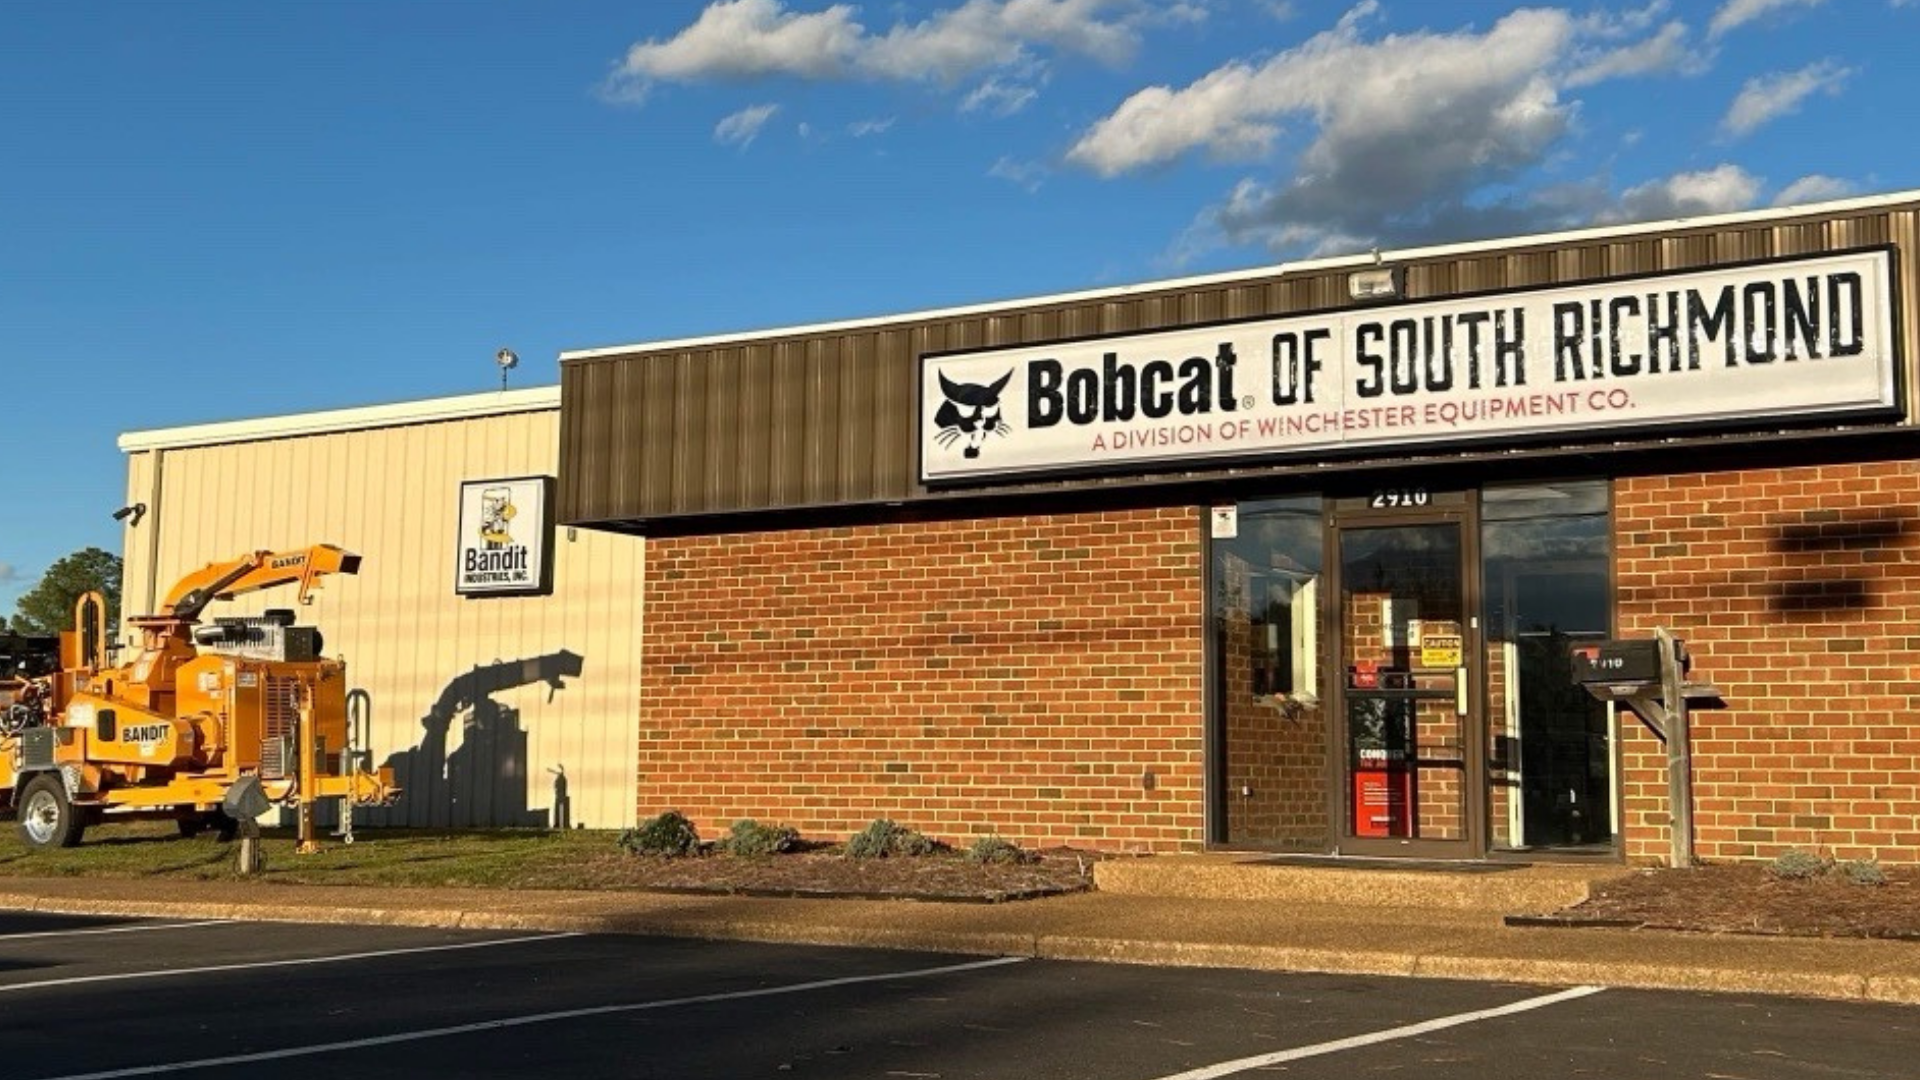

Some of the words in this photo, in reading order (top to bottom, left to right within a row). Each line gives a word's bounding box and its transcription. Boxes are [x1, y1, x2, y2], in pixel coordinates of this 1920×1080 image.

[1028, 342, 1237, 428] Bobcat
[1272, 328, 1331, 406] OF
[1356, 307, 1527, 398] SOUTH
[1553, 271, 1864, 382] RICHMOND
[1092, 433, 1107, 451] A
[1113, 424, 1212, 449] DIVISION
[1219, 419, 1251, 440] OF
[1258, 405, 1416, 438] WINCHESTER
[1425, 393, 1579, 426] EQUIPMENT
[1588, 388, 1636, 411] CO.
[1371, 488, 1428, 508] 2910
[465, 545, 527, 571] Bandit
[122, 724, 170, 743] BANDIT
